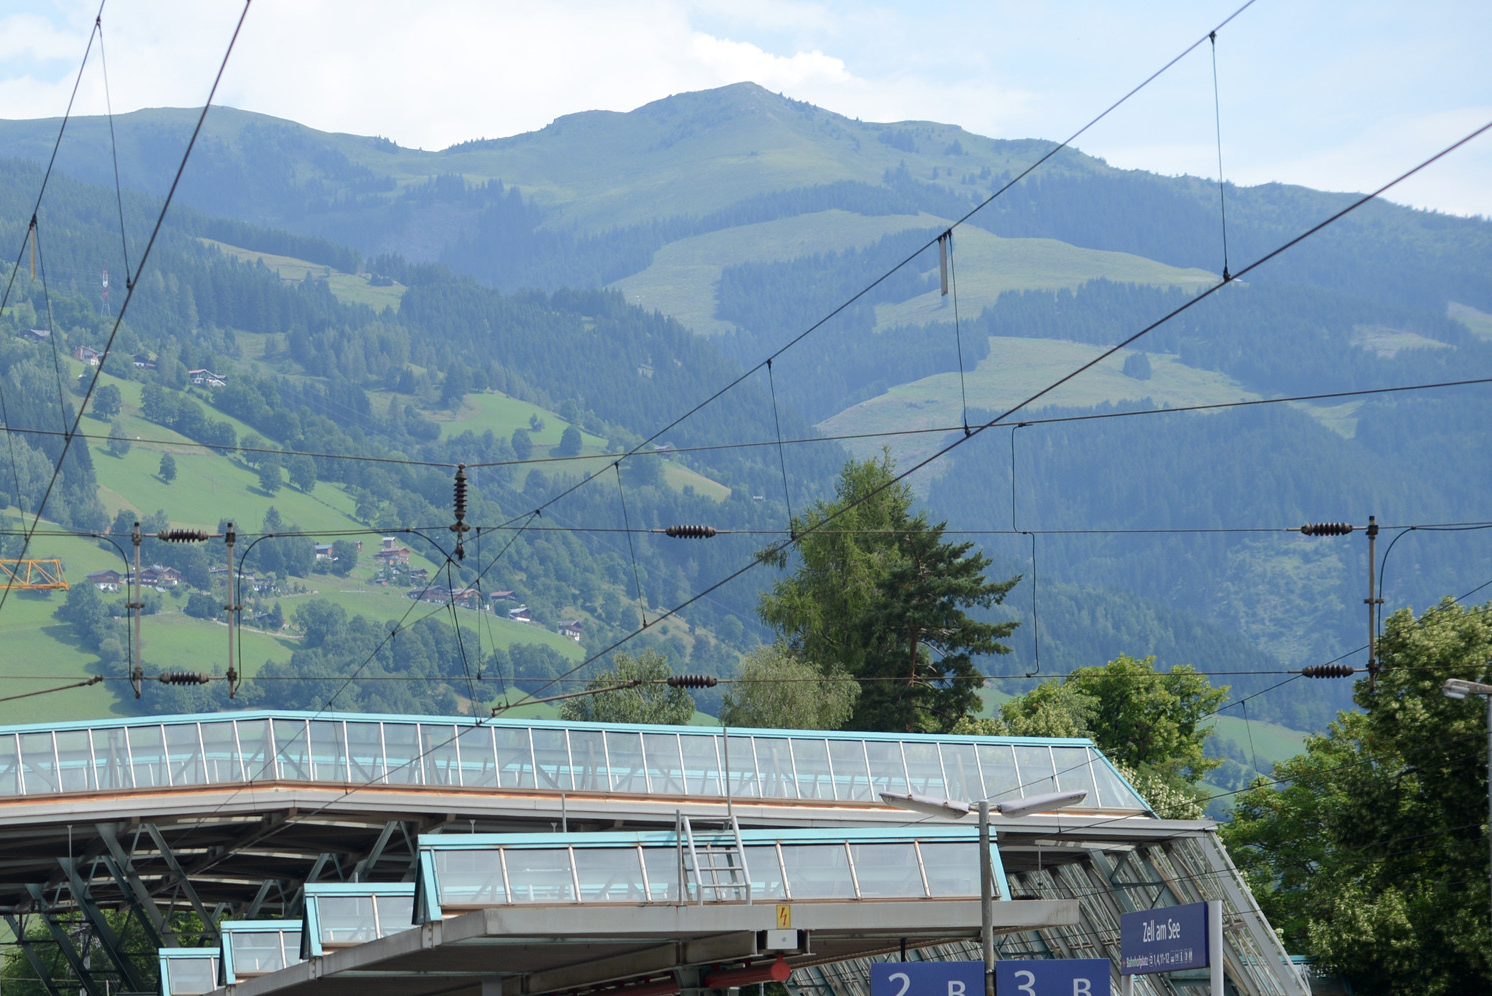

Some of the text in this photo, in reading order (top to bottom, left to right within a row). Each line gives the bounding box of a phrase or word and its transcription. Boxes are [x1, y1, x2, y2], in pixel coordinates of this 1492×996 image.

[1142, 919, 1180, 942] Zell am See
